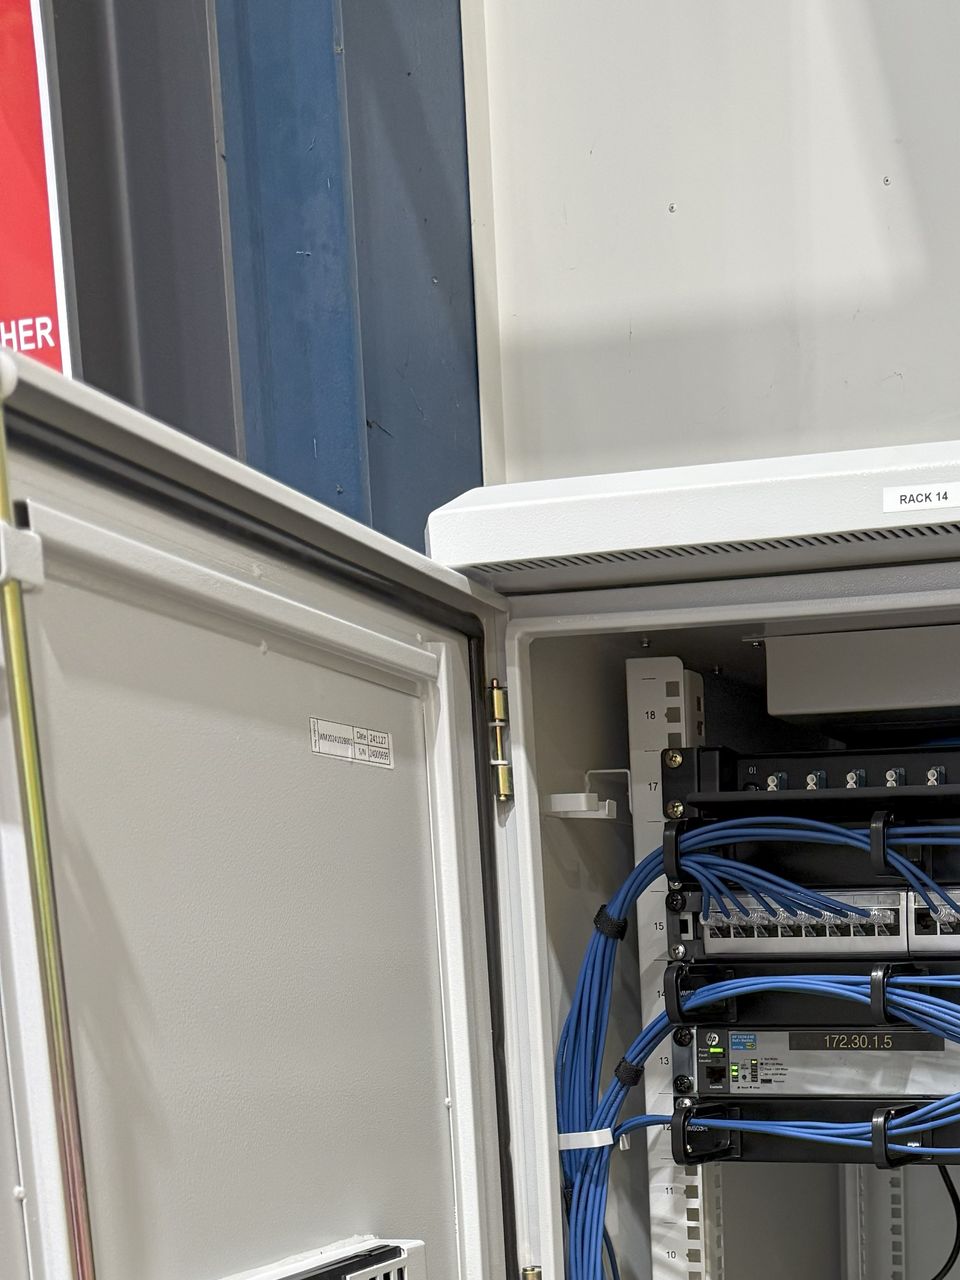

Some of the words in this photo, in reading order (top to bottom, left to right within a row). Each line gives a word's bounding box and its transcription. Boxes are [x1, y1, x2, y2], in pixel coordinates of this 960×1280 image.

[0, 316, 56, 352] HER
[899, 492, 932, 505] RACK
[936, 491, 949, 501] 14
[646, 710, 656, 720] 18
[356, 730, 367, 741] Date
[369, 733, 387, 745] 241127
[649, 782, 659, 791] 17
[654, 922, 665, 931] 15
[824, 1034, 893, 1049] 172.30.1.5
[660, 1057, 670, 1065] 13
[665, 1186, 674, 1195] 11
[666, 1250, 677, 1259] 10
